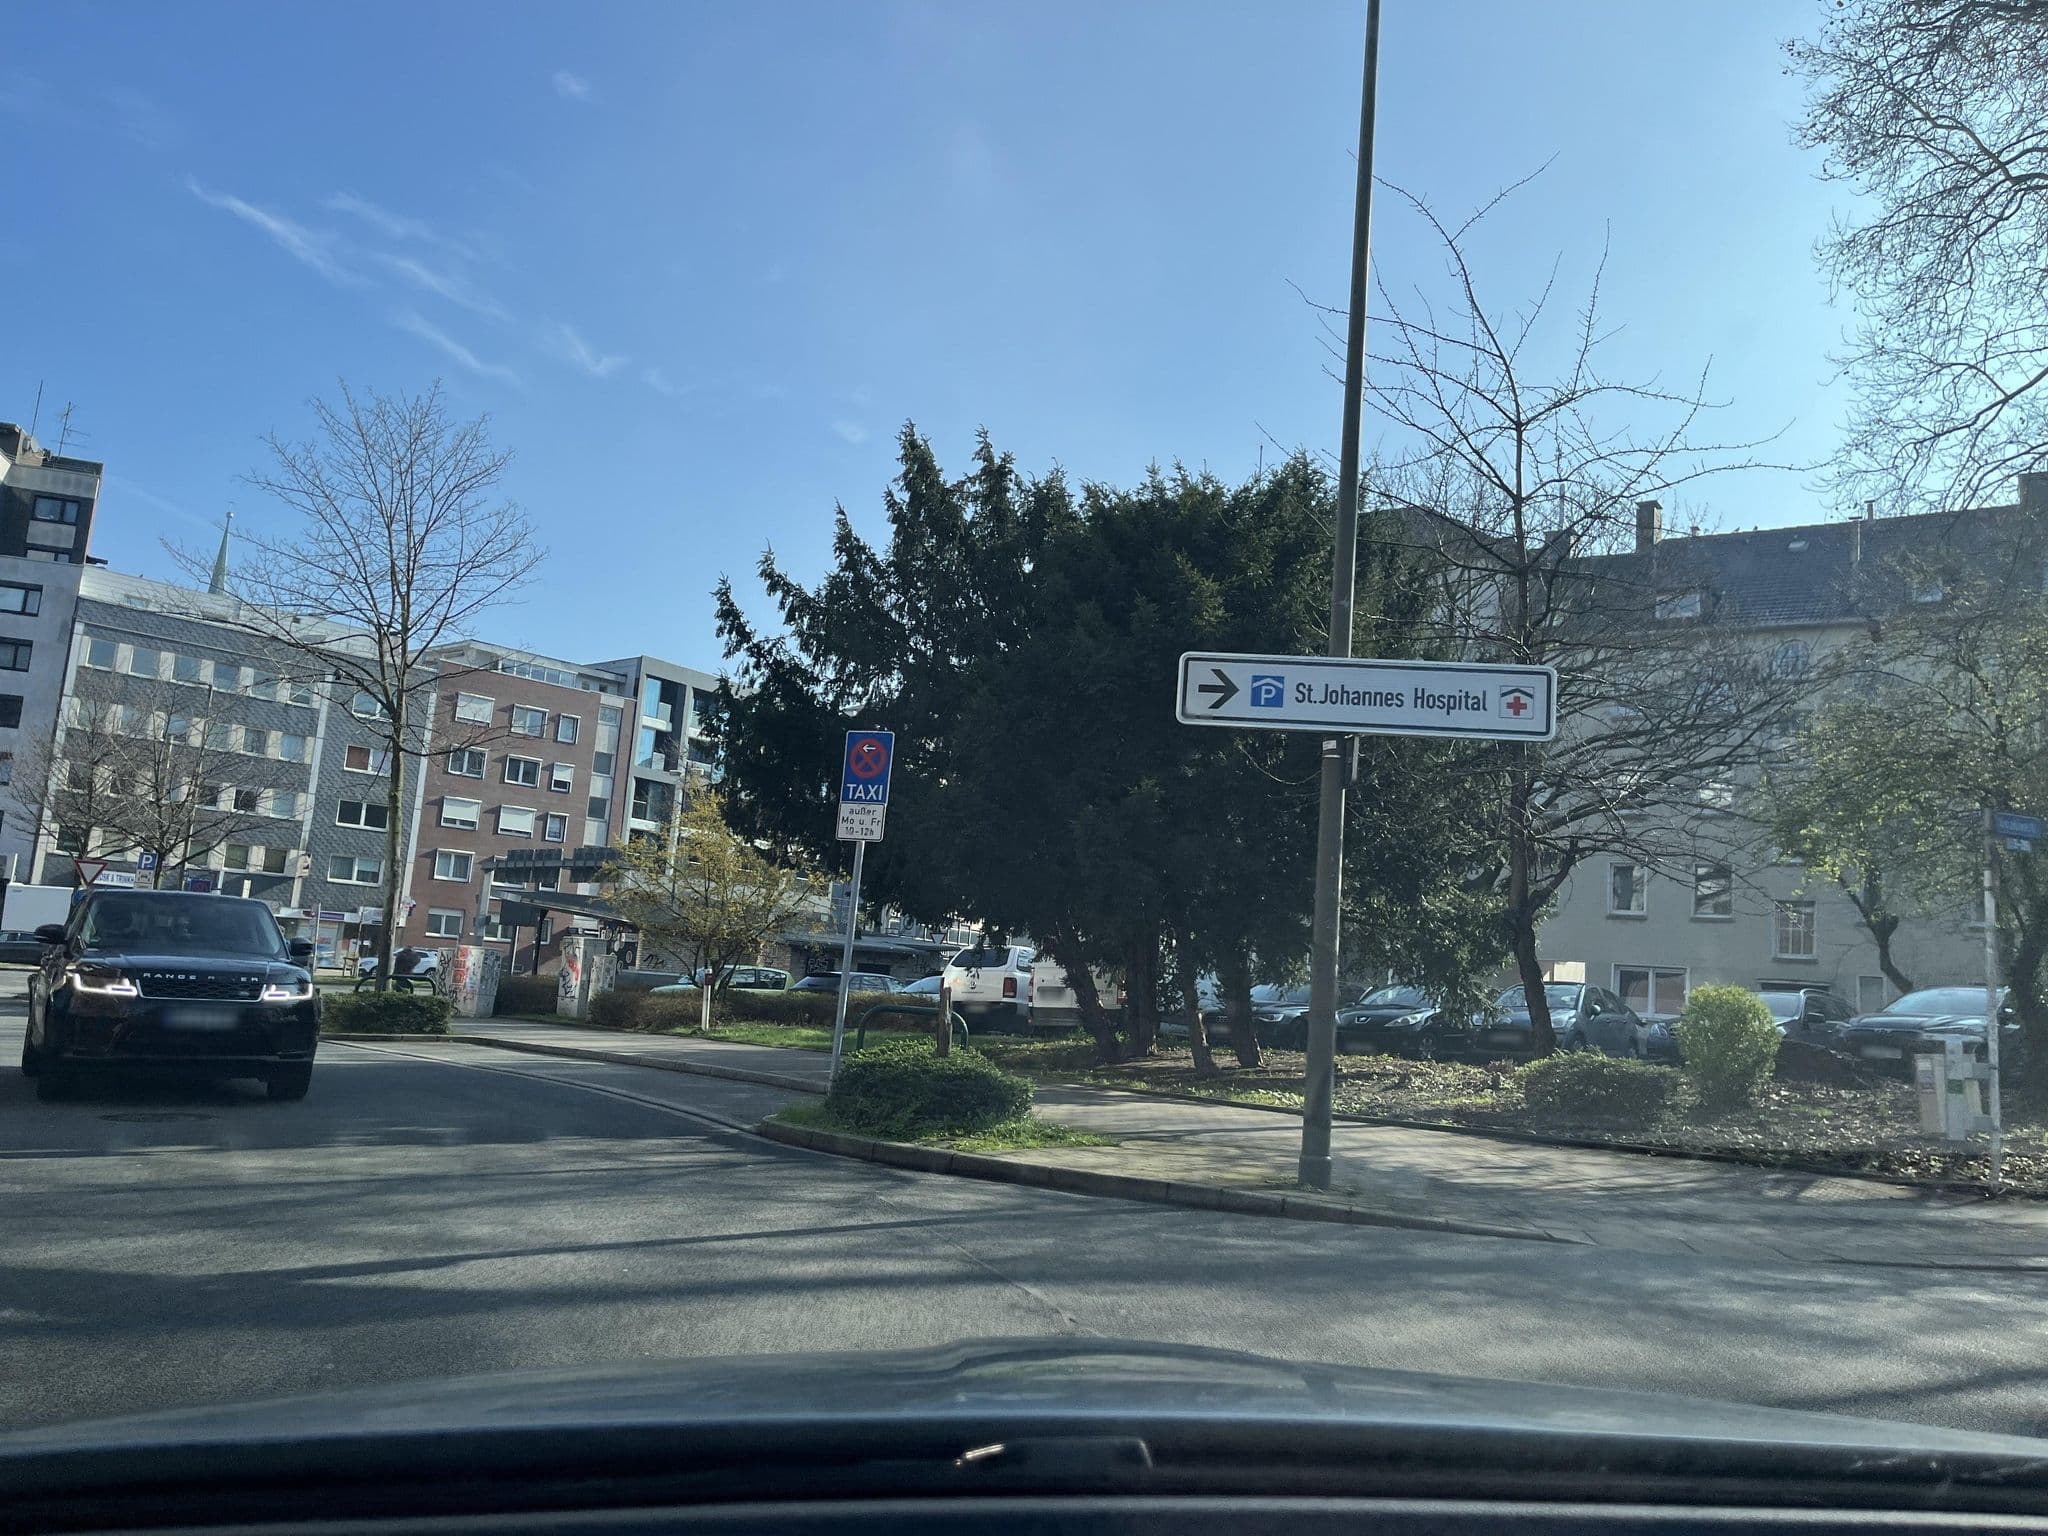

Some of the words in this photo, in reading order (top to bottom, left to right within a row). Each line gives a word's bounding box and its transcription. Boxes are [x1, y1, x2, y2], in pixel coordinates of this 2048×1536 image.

[1413, 687, 1487, 715] Hospital
[846, 784, 883, 801] TAXI
[848, 807, 877, 816] außer
[841, 816, 855, 825] Mo
[858, 818, 867, 826] u.
[870, 817, 881, 826] Fr
[141, 855, 152, 869] P
[143, 972, 197, 980] RANGE
